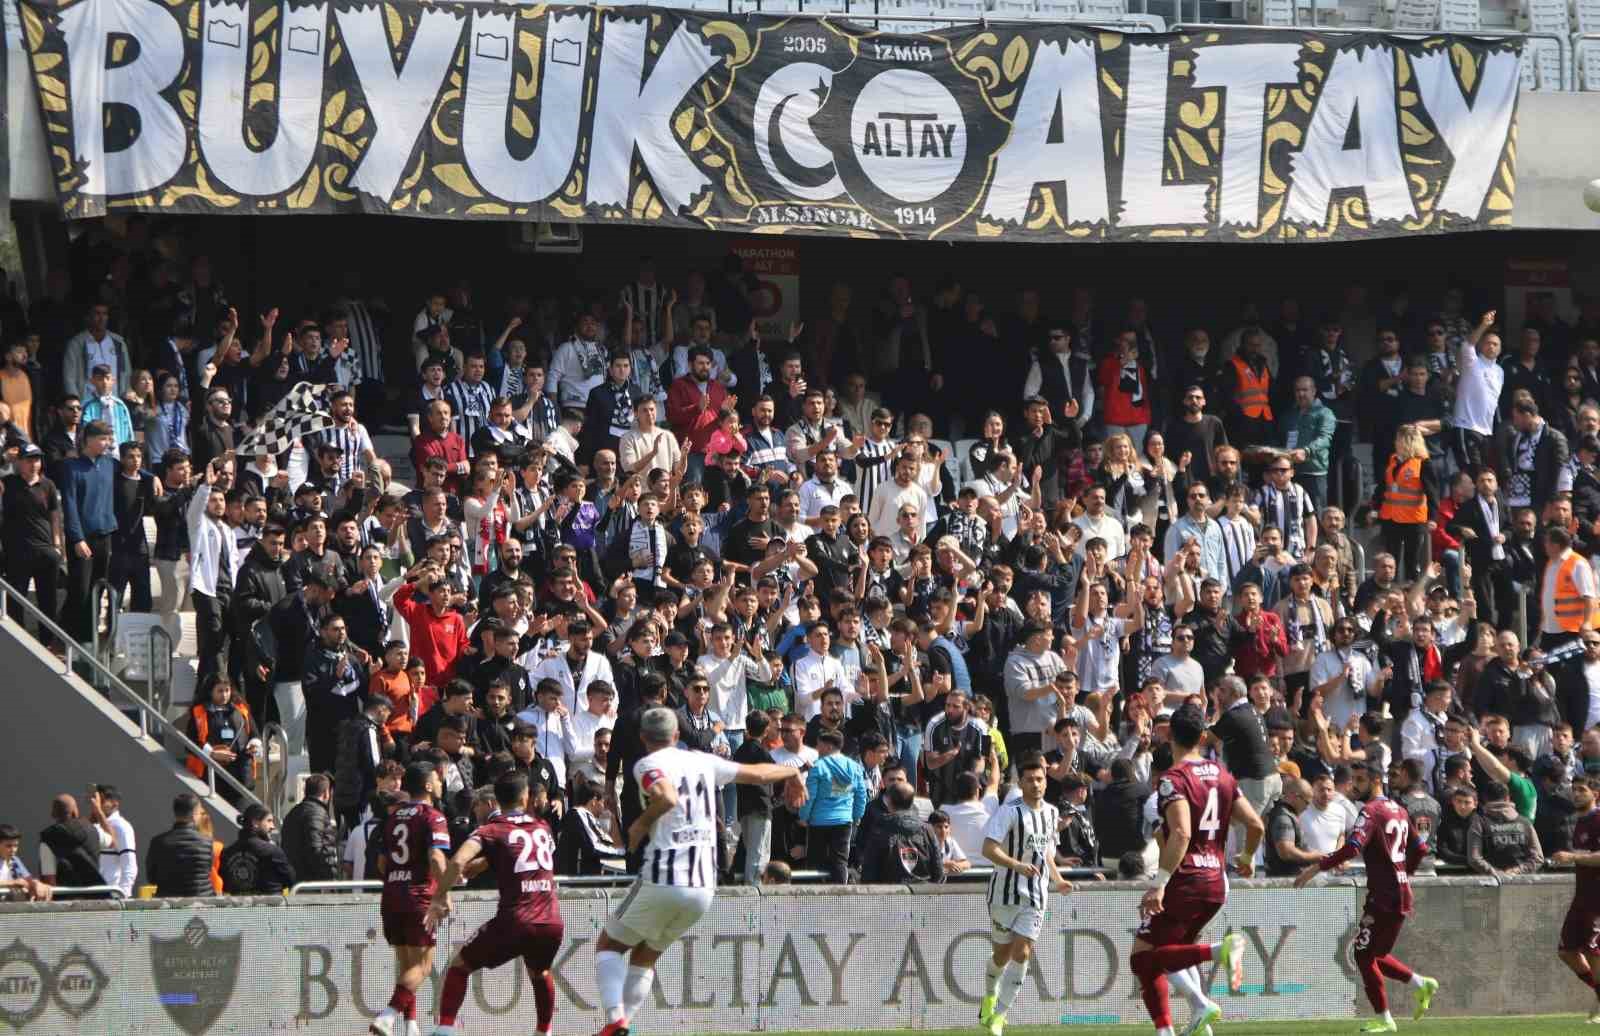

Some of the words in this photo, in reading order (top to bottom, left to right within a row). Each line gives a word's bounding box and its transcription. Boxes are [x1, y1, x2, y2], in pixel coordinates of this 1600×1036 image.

[783, 36, 827, 54] 2005
[862, 112, 956, 158] ALTAY
[981, 36, 1522, 229] ALTAY
[894, 207, 937, 225] 1914
[678, 773, 712, 824] 11
[1198, 787, 1221, 841] 4
[391, 823, 409, 865] 3
[508, 828, 554, 873] 28
